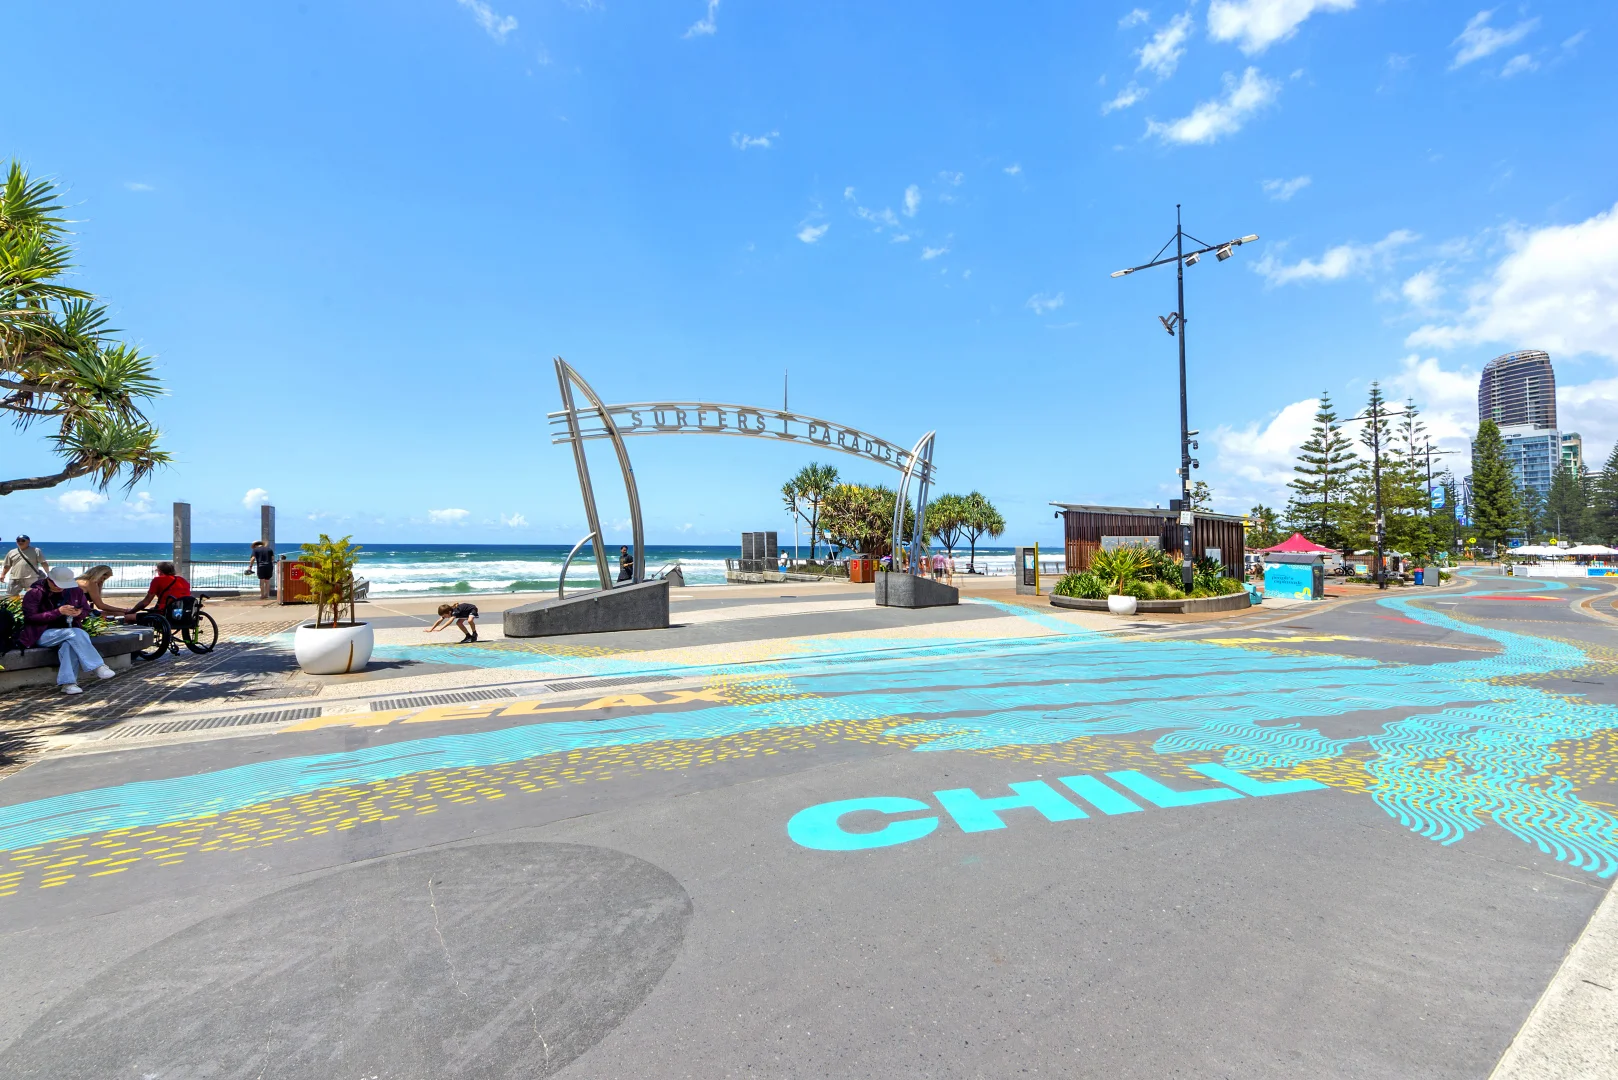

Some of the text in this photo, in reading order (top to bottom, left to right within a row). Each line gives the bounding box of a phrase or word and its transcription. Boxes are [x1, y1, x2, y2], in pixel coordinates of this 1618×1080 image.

[631, 410, 904, 465] SURFERS PARADISE
[275, 688, 733, 733] RELAX
[787, 763, 1330, 851] CHILL
